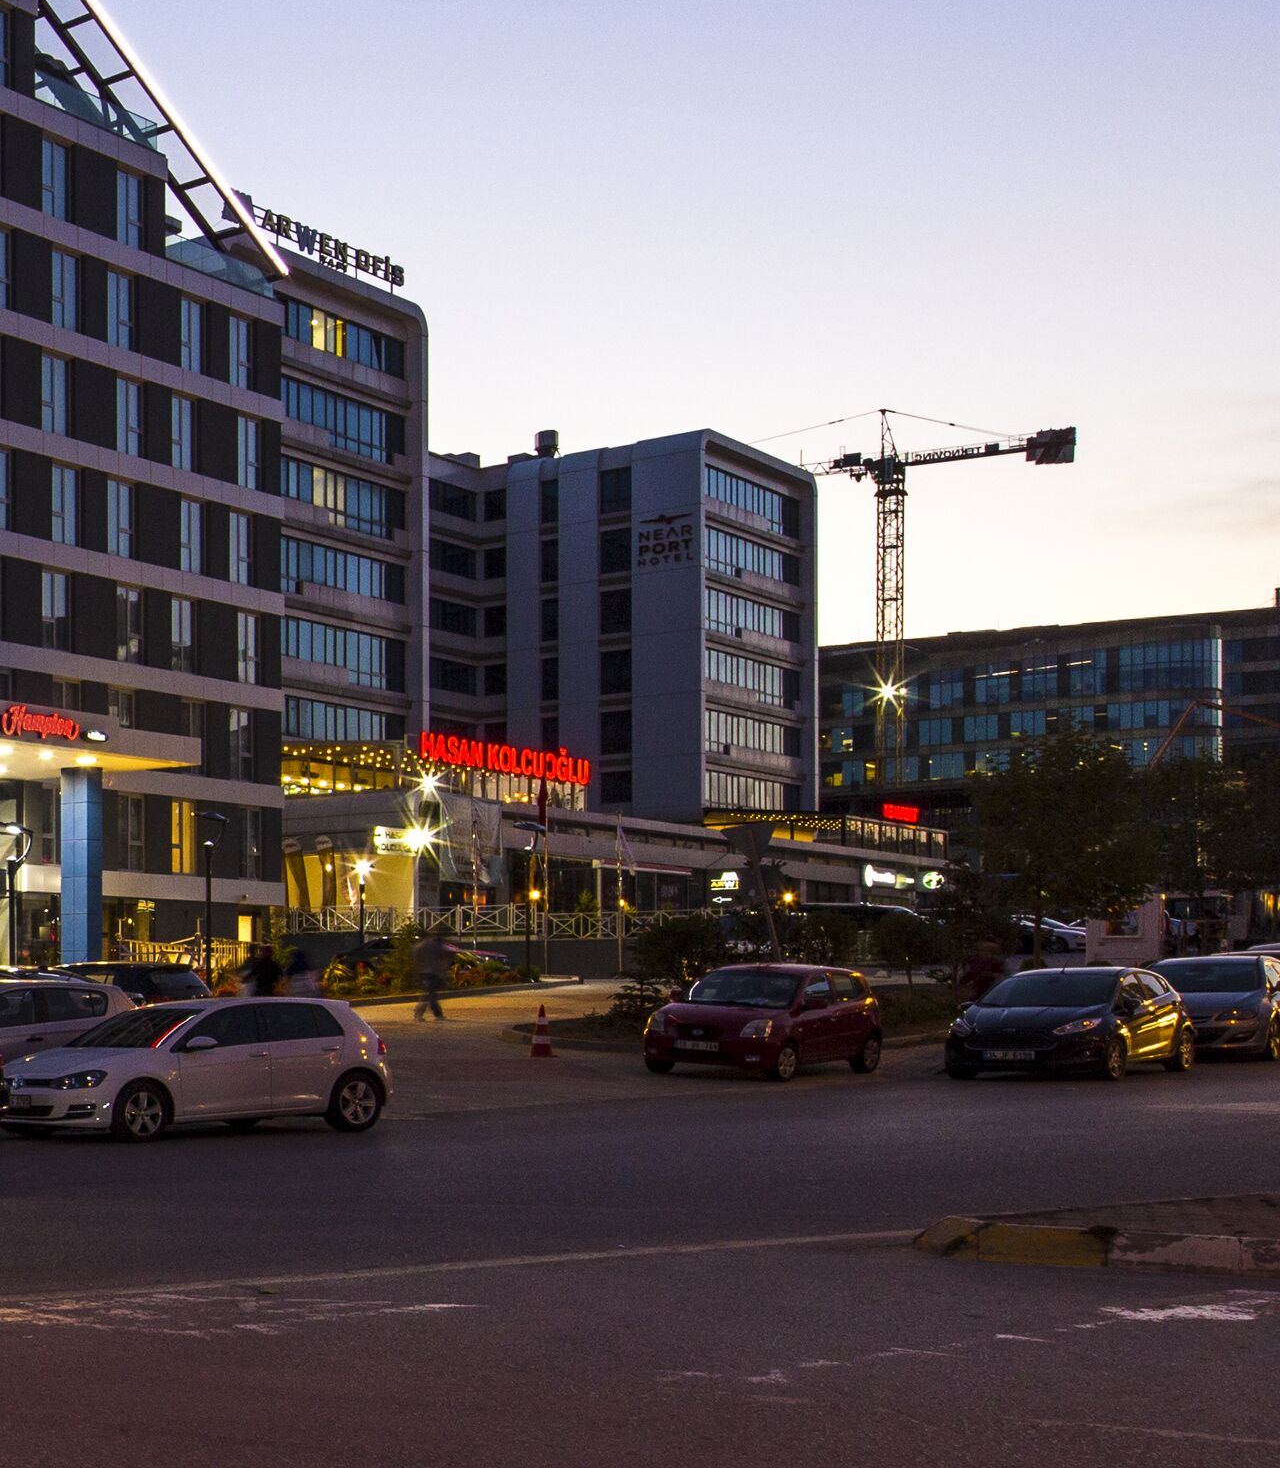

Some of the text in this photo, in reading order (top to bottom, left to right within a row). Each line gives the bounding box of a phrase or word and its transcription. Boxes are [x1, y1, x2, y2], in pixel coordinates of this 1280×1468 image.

[262, 208, 348, 261] ARWEN
[638, 525, 693, 543] NEAR
[638, 538, 693, 556] PORT
[638, 552, 694, 567] HOTEL
[1, 703, 80, 741] Hampton
[421, 731, 591, 787] HASAN KOLCUOĞLU
